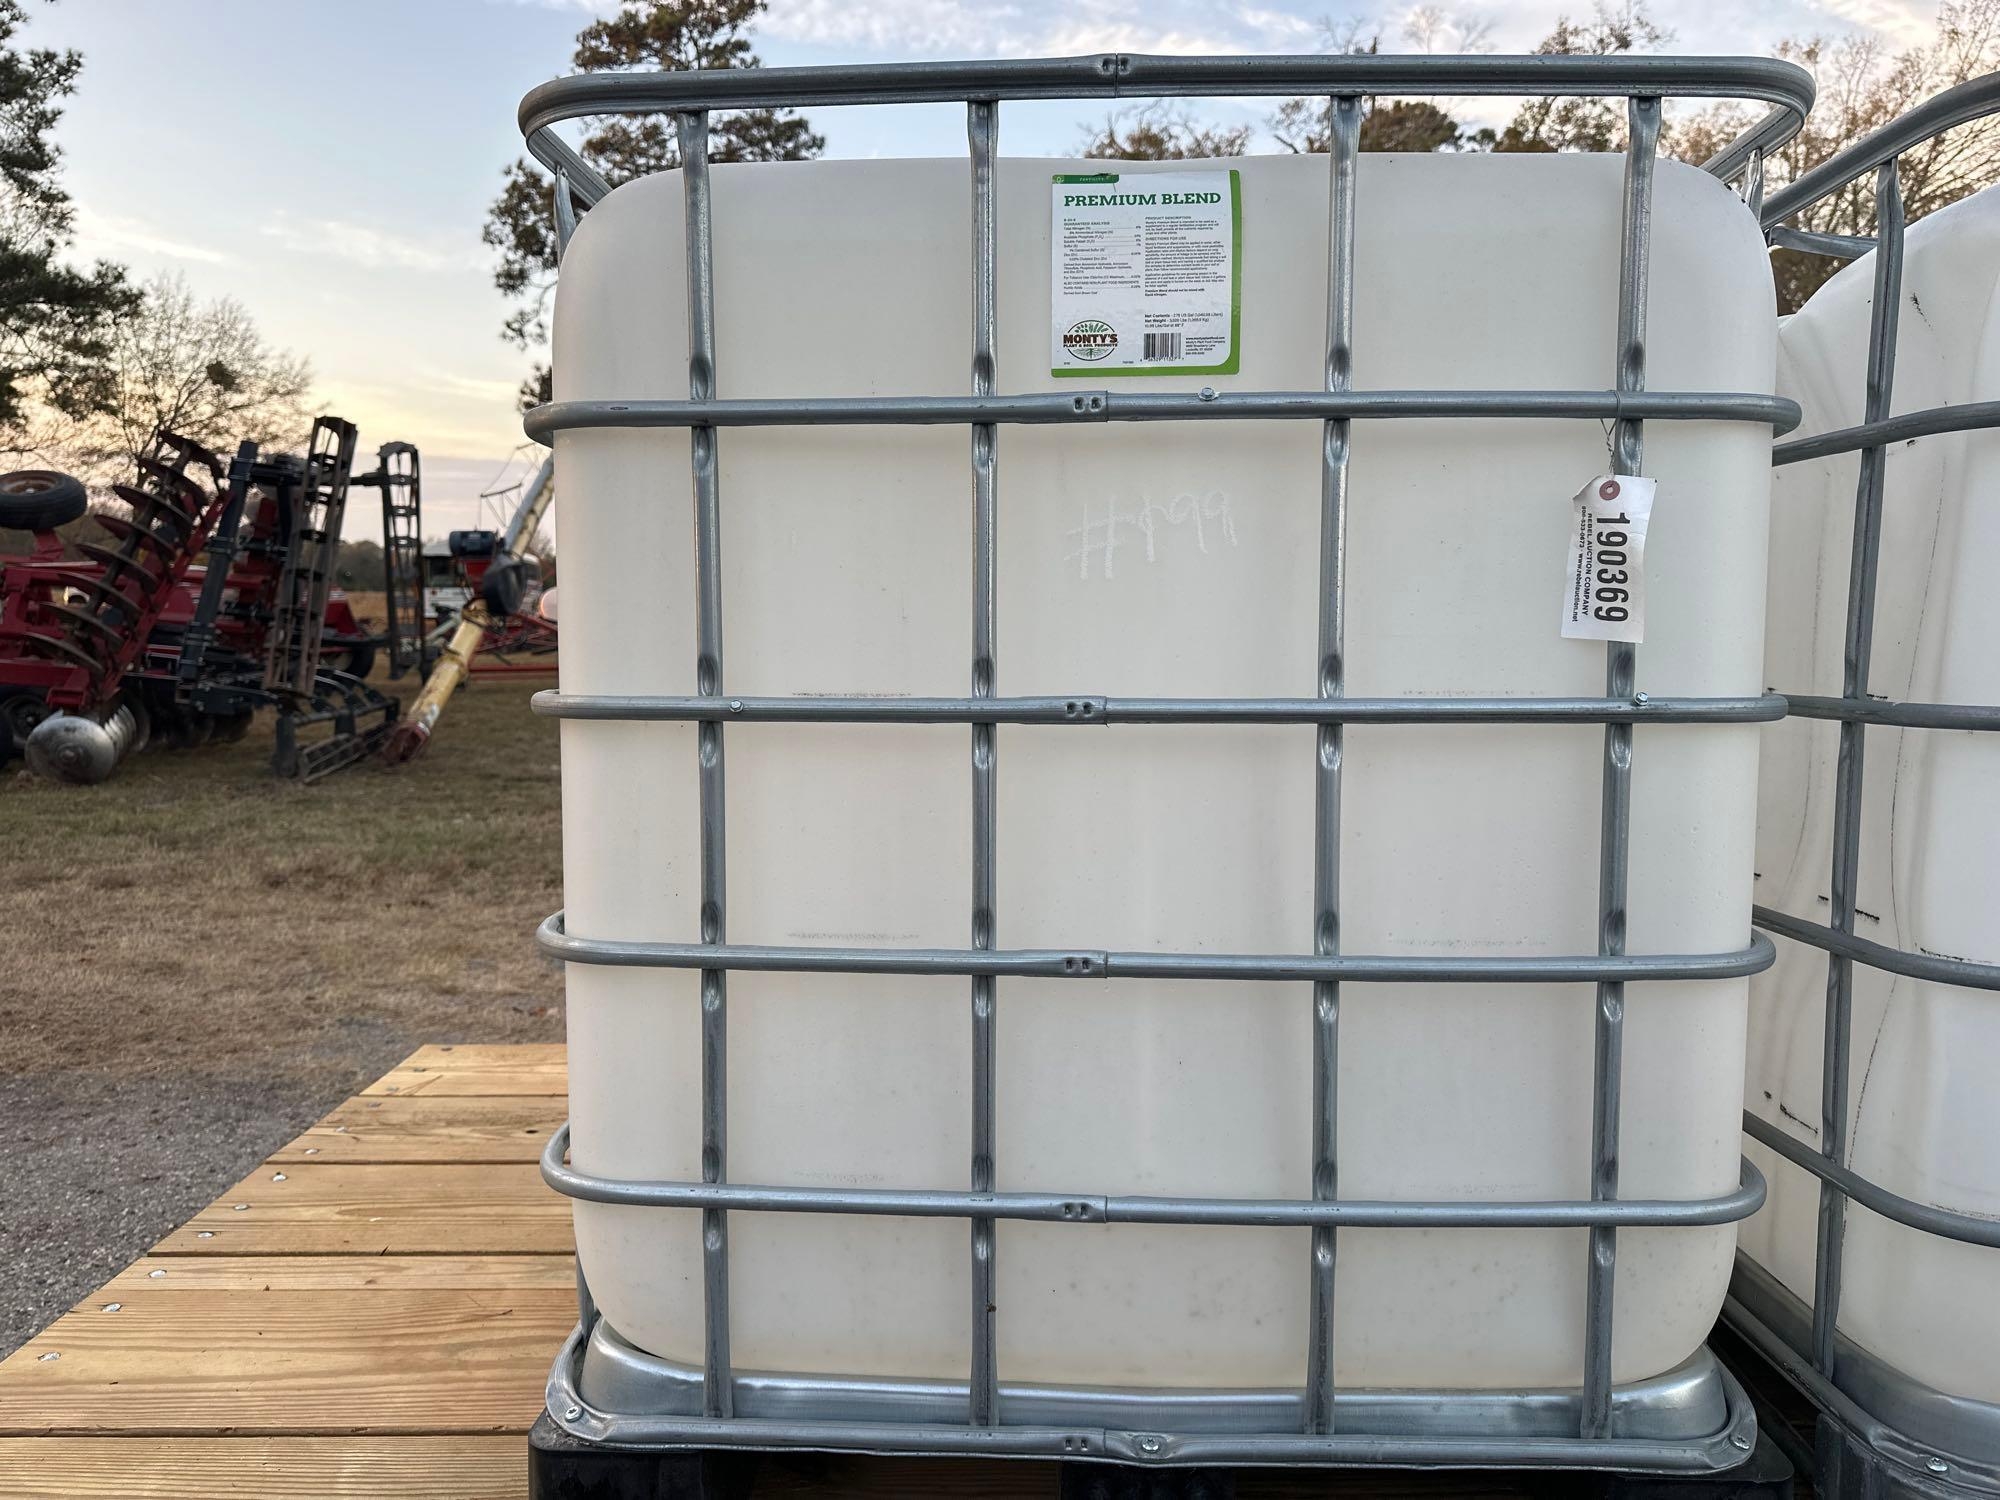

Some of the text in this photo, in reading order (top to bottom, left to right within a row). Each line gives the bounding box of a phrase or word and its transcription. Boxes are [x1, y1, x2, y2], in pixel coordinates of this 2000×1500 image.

[1063, 192, 1221, 207] PREMIUM BLEND
[1063, 333, 1118, 344] MONTY'S
[1585, 541, 1593, 575] AUCTION
[1594, 512, 1631, 622] 190369
[1582, 577, 1592, 616] COMPANY
